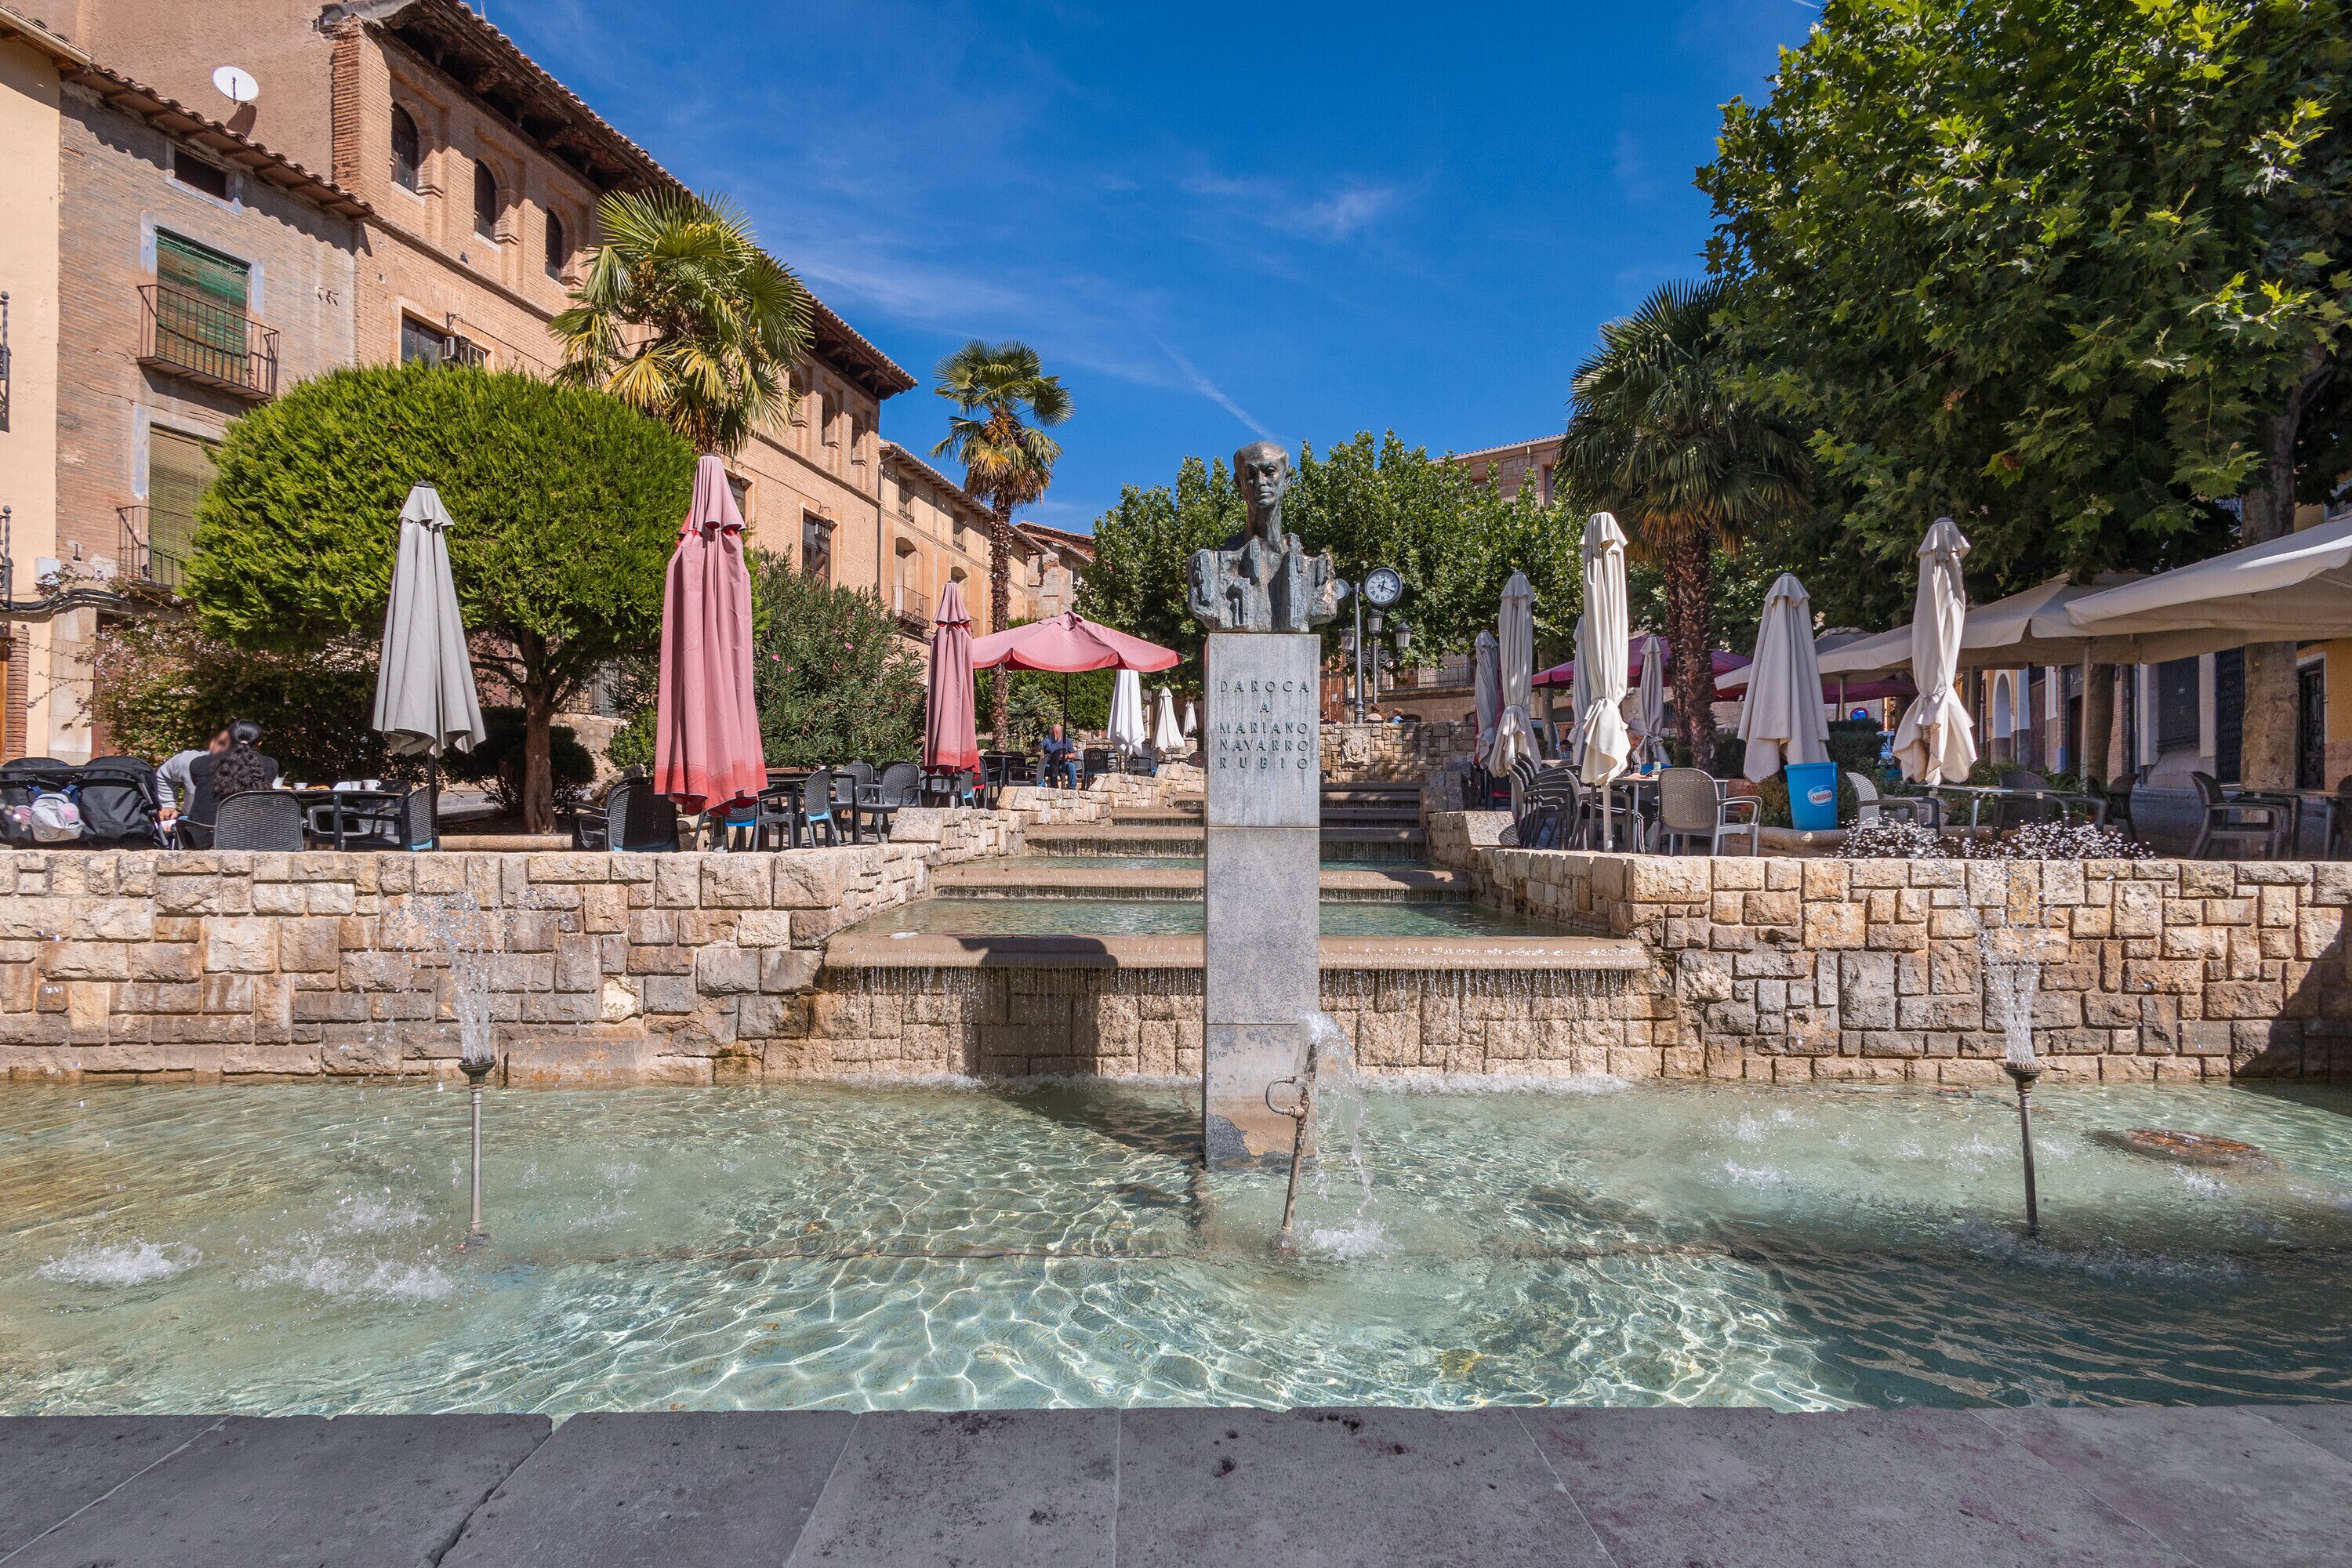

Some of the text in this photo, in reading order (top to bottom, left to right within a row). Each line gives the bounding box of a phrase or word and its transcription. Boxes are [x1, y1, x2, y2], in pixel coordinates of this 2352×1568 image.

[1220, 681, 1309, 692] DAROCA
[1259, 702, 1269, 713] A
[1219, 722, 1308, 734] MARIANO
[1219, 739, 1308, 752] NAVARRO
[1219, 757, 1308, 769] RUBIO
